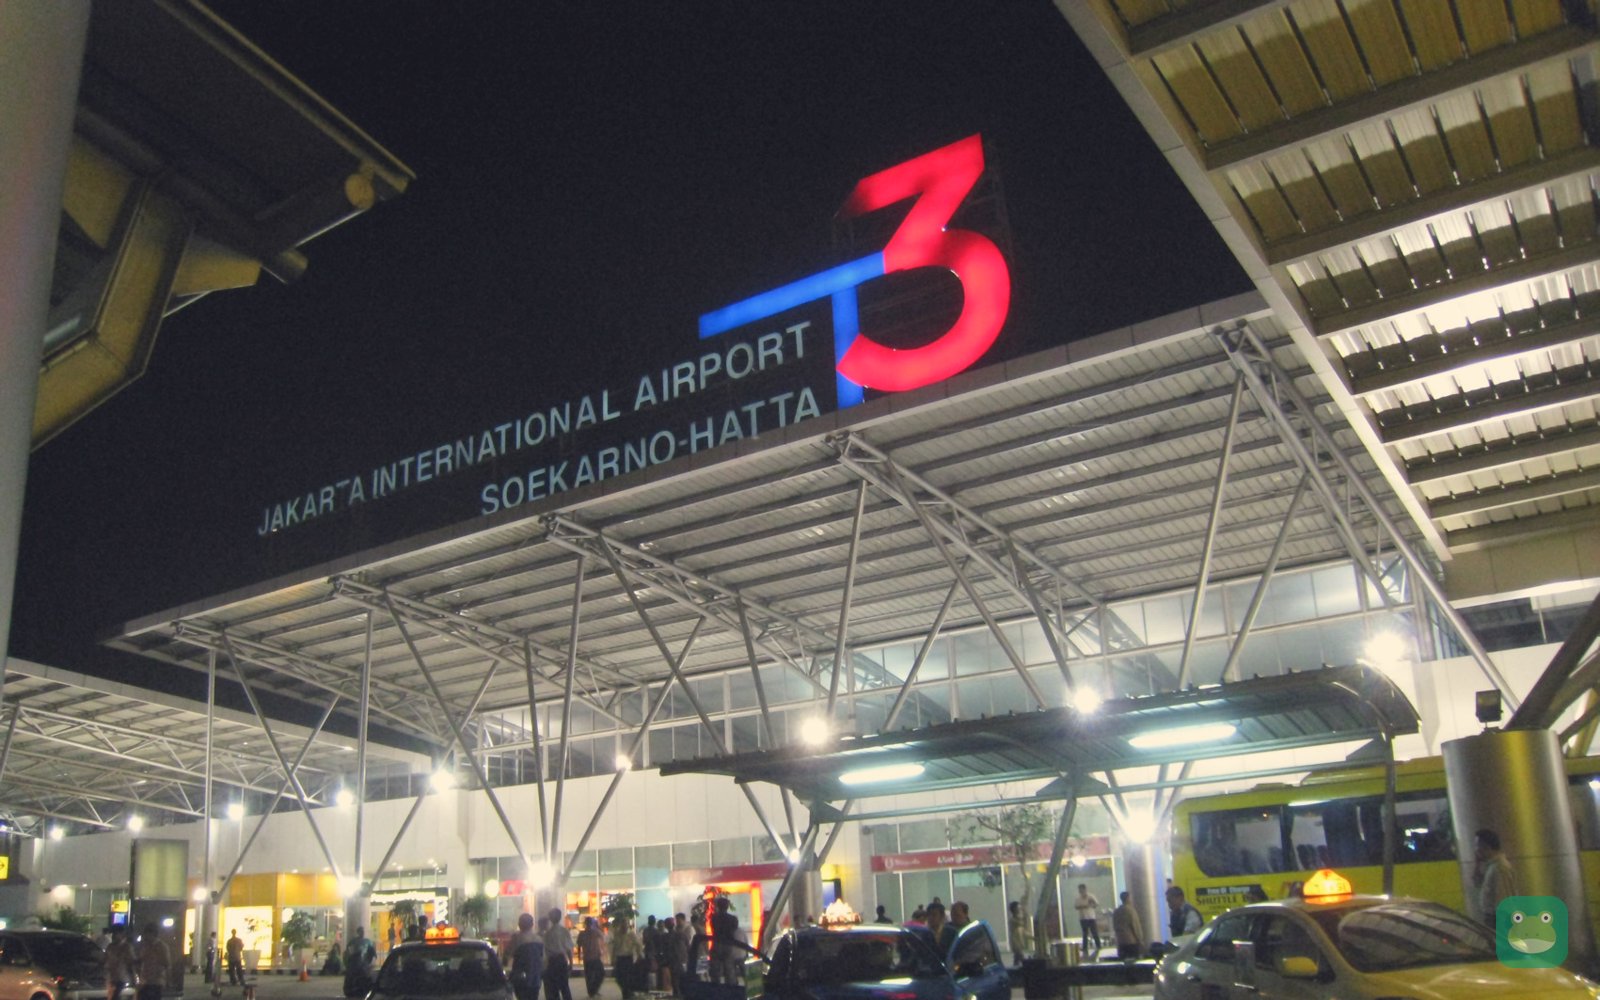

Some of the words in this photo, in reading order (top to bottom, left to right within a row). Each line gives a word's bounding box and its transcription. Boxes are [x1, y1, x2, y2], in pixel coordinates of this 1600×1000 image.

[372, 389, 621, 499] INTERNATIONAL
[634, 321, 811, 411] AIRPORT
[481, 386, 821, 516] SOEKARNO-HATTA
